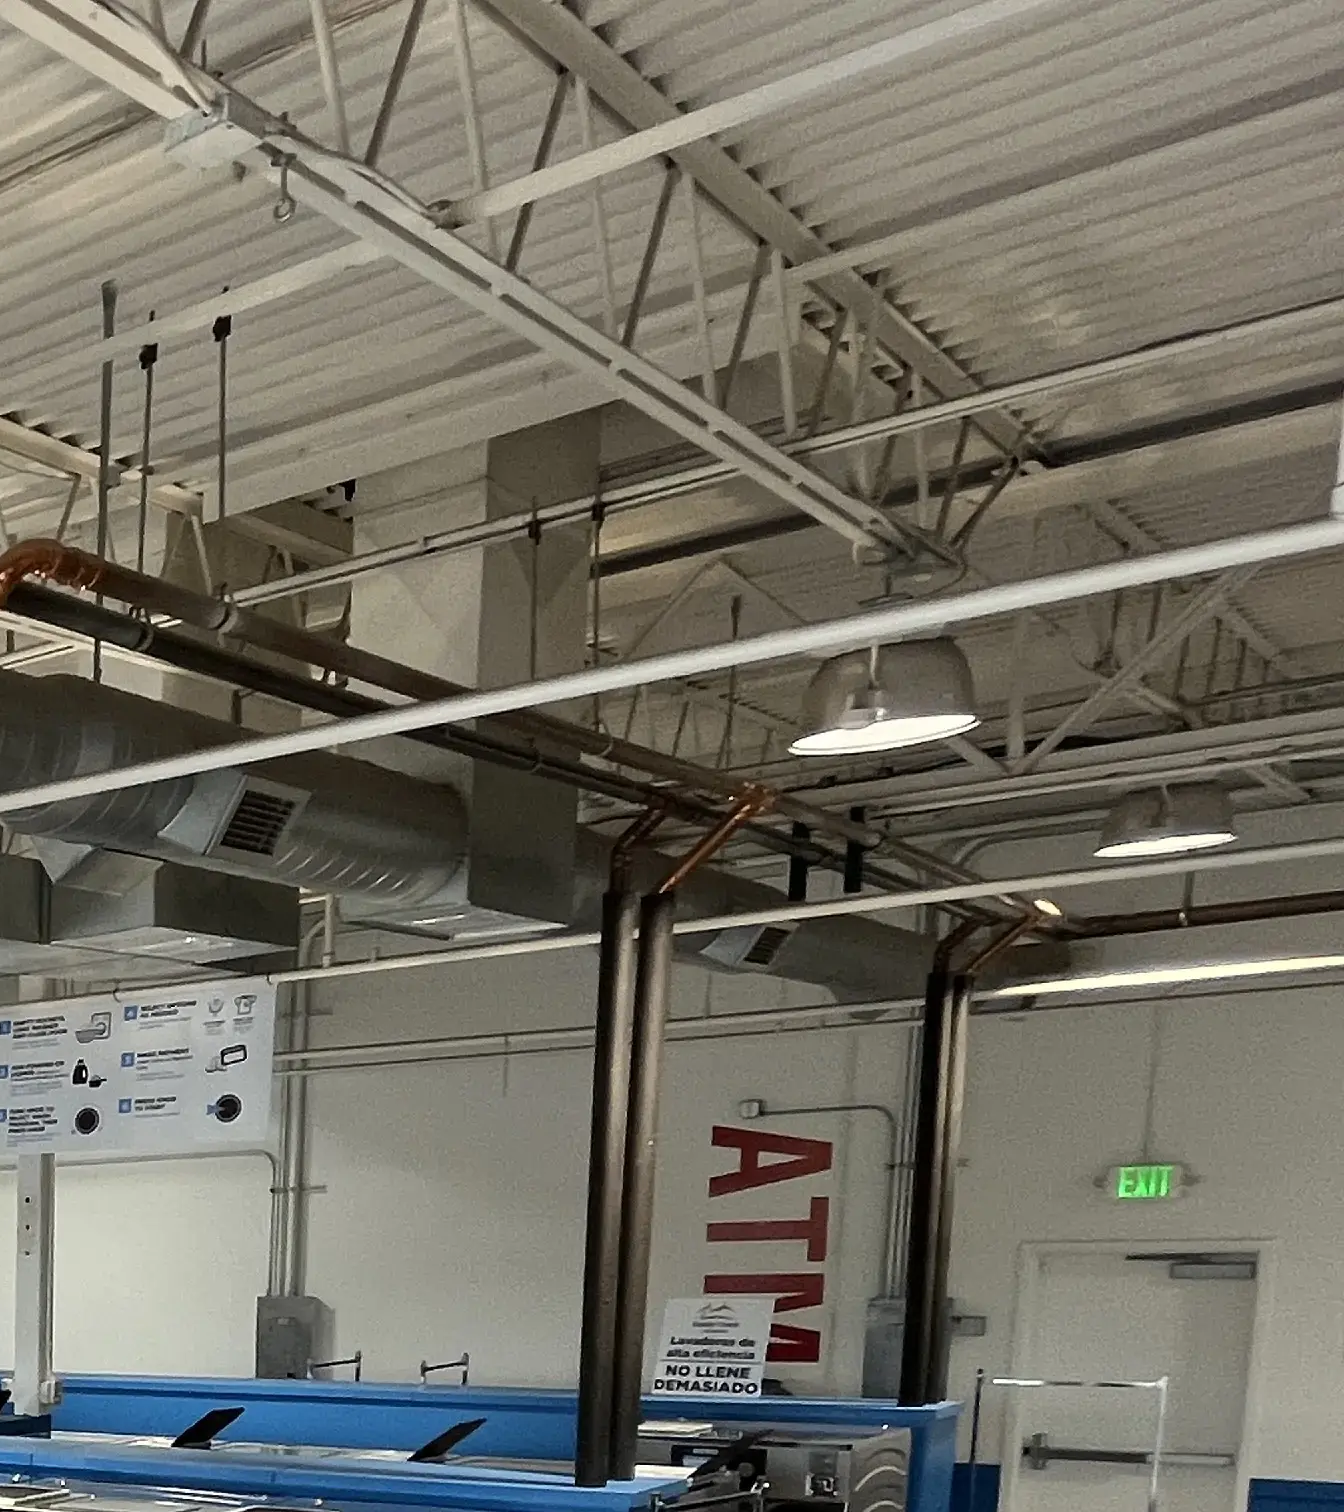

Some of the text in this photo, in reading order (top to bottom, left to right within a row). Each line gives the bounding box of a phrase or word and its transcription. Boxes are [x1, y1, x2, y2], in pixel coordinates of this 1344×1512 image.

[1118, 1166, 1173, 1198] EXIT
[703, 1125, 833, 1362] ATM
[665, 1364, 752, 1379] NO LLENE
[653, 1378, 759, 1394] DEMASIADO
